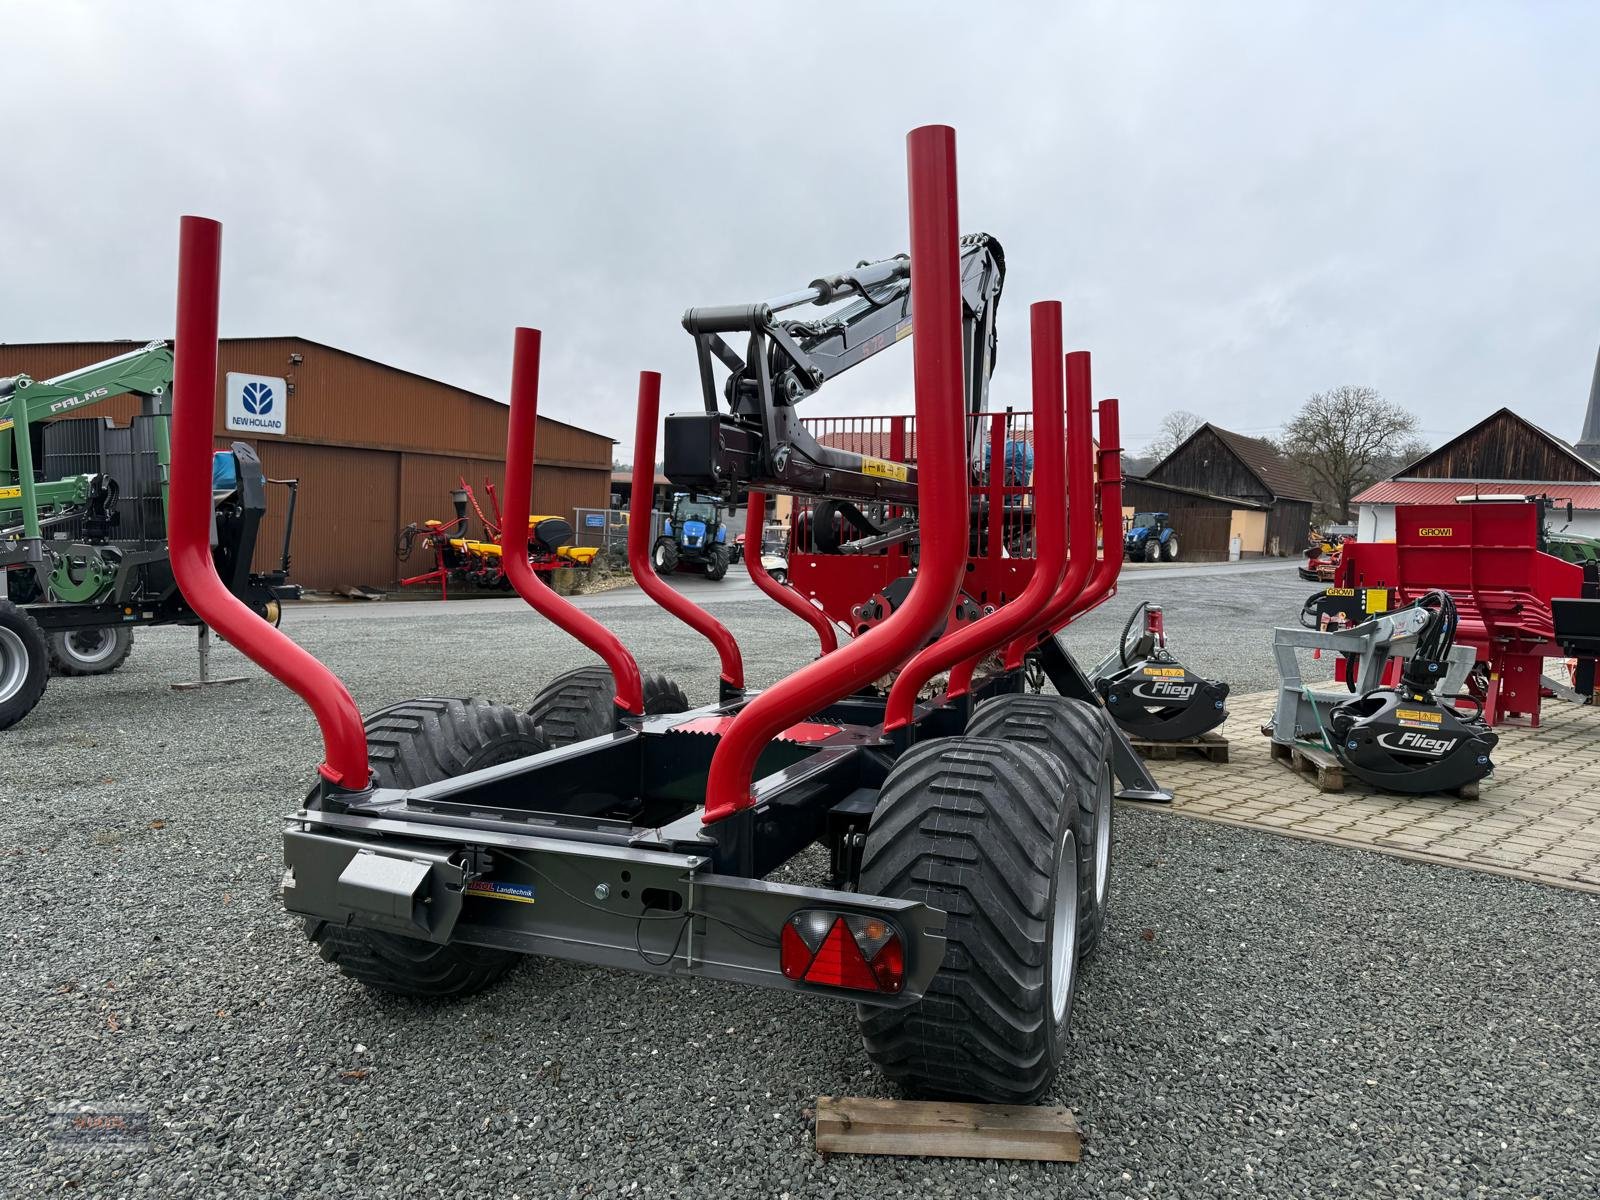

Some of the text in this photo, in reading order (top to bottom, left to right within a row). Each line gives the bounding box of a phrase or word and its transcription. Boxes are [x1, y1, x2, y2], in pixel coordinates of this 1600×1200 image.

[50, 387, 109, 413] PALMS
[232, 416, 282, 429] NEW HOLLAND
[1420, 528, 1451, 536] GROWI
[1327, 588, 1353, 596] GROWI
[1151, 681, 1198, 698] Fliegl
[1398, 732, 1458, 753] Fliegl
[496, 885, 533, 898] Landtechnik
